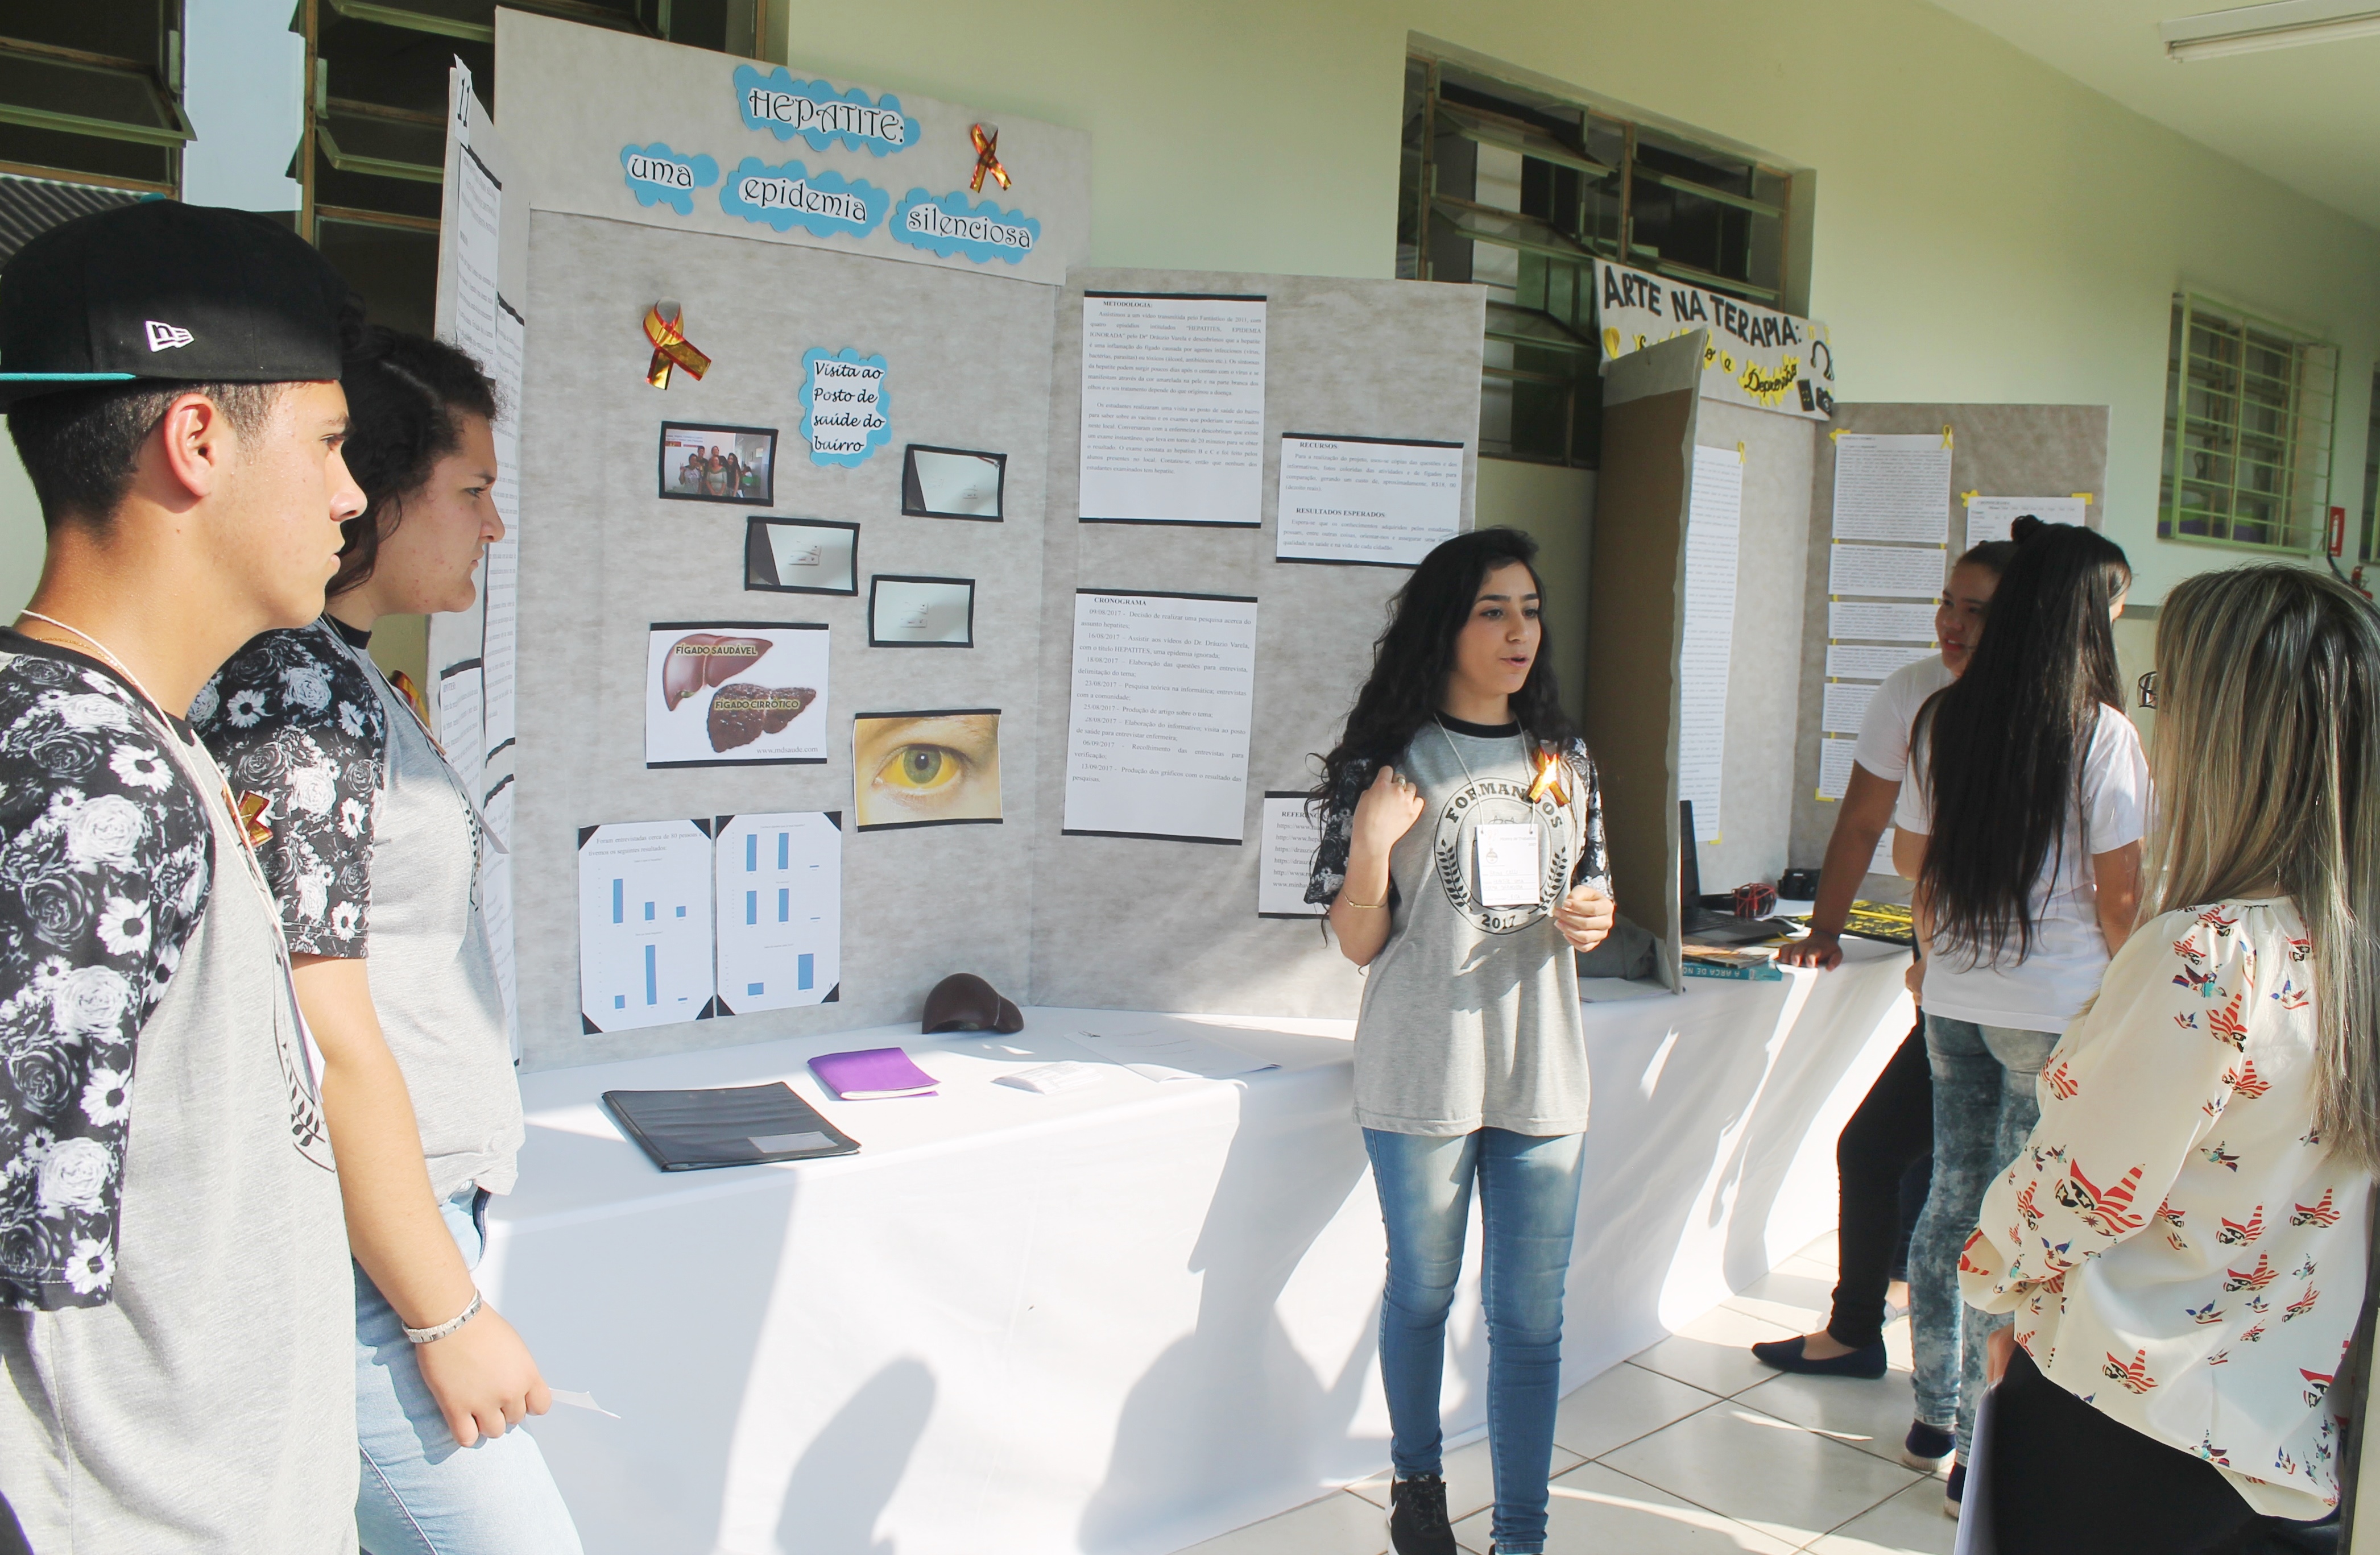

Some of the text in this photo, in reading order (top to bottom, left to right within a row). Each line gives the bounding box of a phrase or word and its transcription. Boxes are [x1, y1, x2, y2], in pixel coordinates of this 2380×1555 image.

[749, 89, 905, 143] HEPATITE:
[631, 156, 1030, 248] uma epidemia silenciosa
[1604, 266, 1662, 316] ARTE
[1671, 289, 1707, 322] NA
[1710, 295, 1802, 347] TERAPIA:
[816, 362, 884, 379] Visita ao
[814, 388, 878, 403] Posto de
[814, 413, 885, 428] saúde do
[814, 436, 864, 451] bairro
[1094, 597, 1146, 606] CRONOGRAMA
[676, 644, 756, 654] FÍGADO SAUDÁVEL
[715, 699, 798, 708] FÍGADO CIRRÓTICO
[1125, 719, 1156, 728] Elaboração
[1445, 783, 1562, 828] FORMANOS
[1481, 914, 1516, 928] 2017
